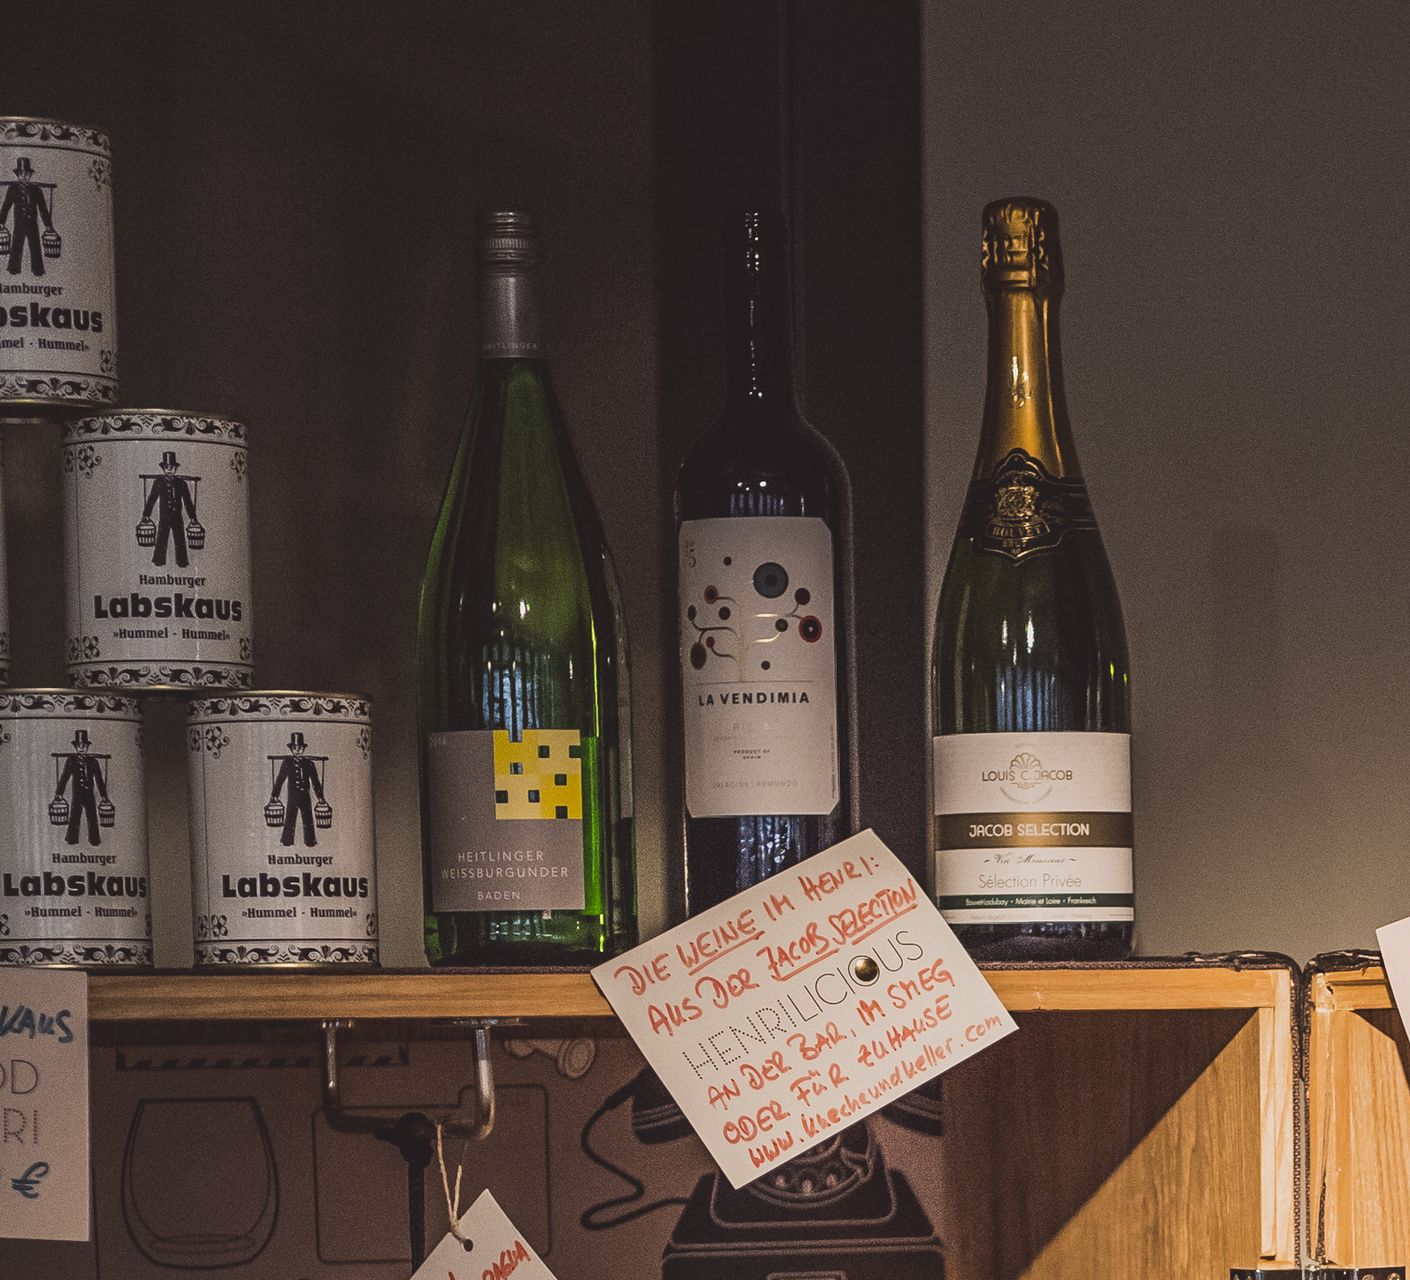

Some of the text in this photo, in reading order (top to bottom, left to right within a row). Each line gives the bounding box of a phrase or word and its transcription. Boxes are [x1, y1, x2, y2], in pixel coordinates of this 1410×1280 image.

[0, 283, 63, 297] amburger
[139, 574, 206, 588] Hamburger
[94, 593, 242, 622] Labskaus
[699, 691, 810, 706] LA VENDIMIA
[982, 769, 1073, 781] LOUIS JACOB
[969, 822, 1090, 838] JACOB SELECTION
[52, 852, 117, 866] Hamburger
[267, 854, 334, 867] Hamburger
[458, 850, 544, 863] HEITLINGER
[441, 866, 569, 880] WEISSBURGUNDER
[3, 871, 147, 897] Labskaus
[222, 872, 369, 898] Labskaus
[978, 873, 1082, 889] Sélection Privée
[477, 891, 521, 901] BADEN
[614, 894, 795, 995] DIE WEINE IM
[696, 968, 760, 1010] DER
[707, 958, 957, 1111] AN DER IM SMEG
[722, 1100, 792, 1144] ODER
